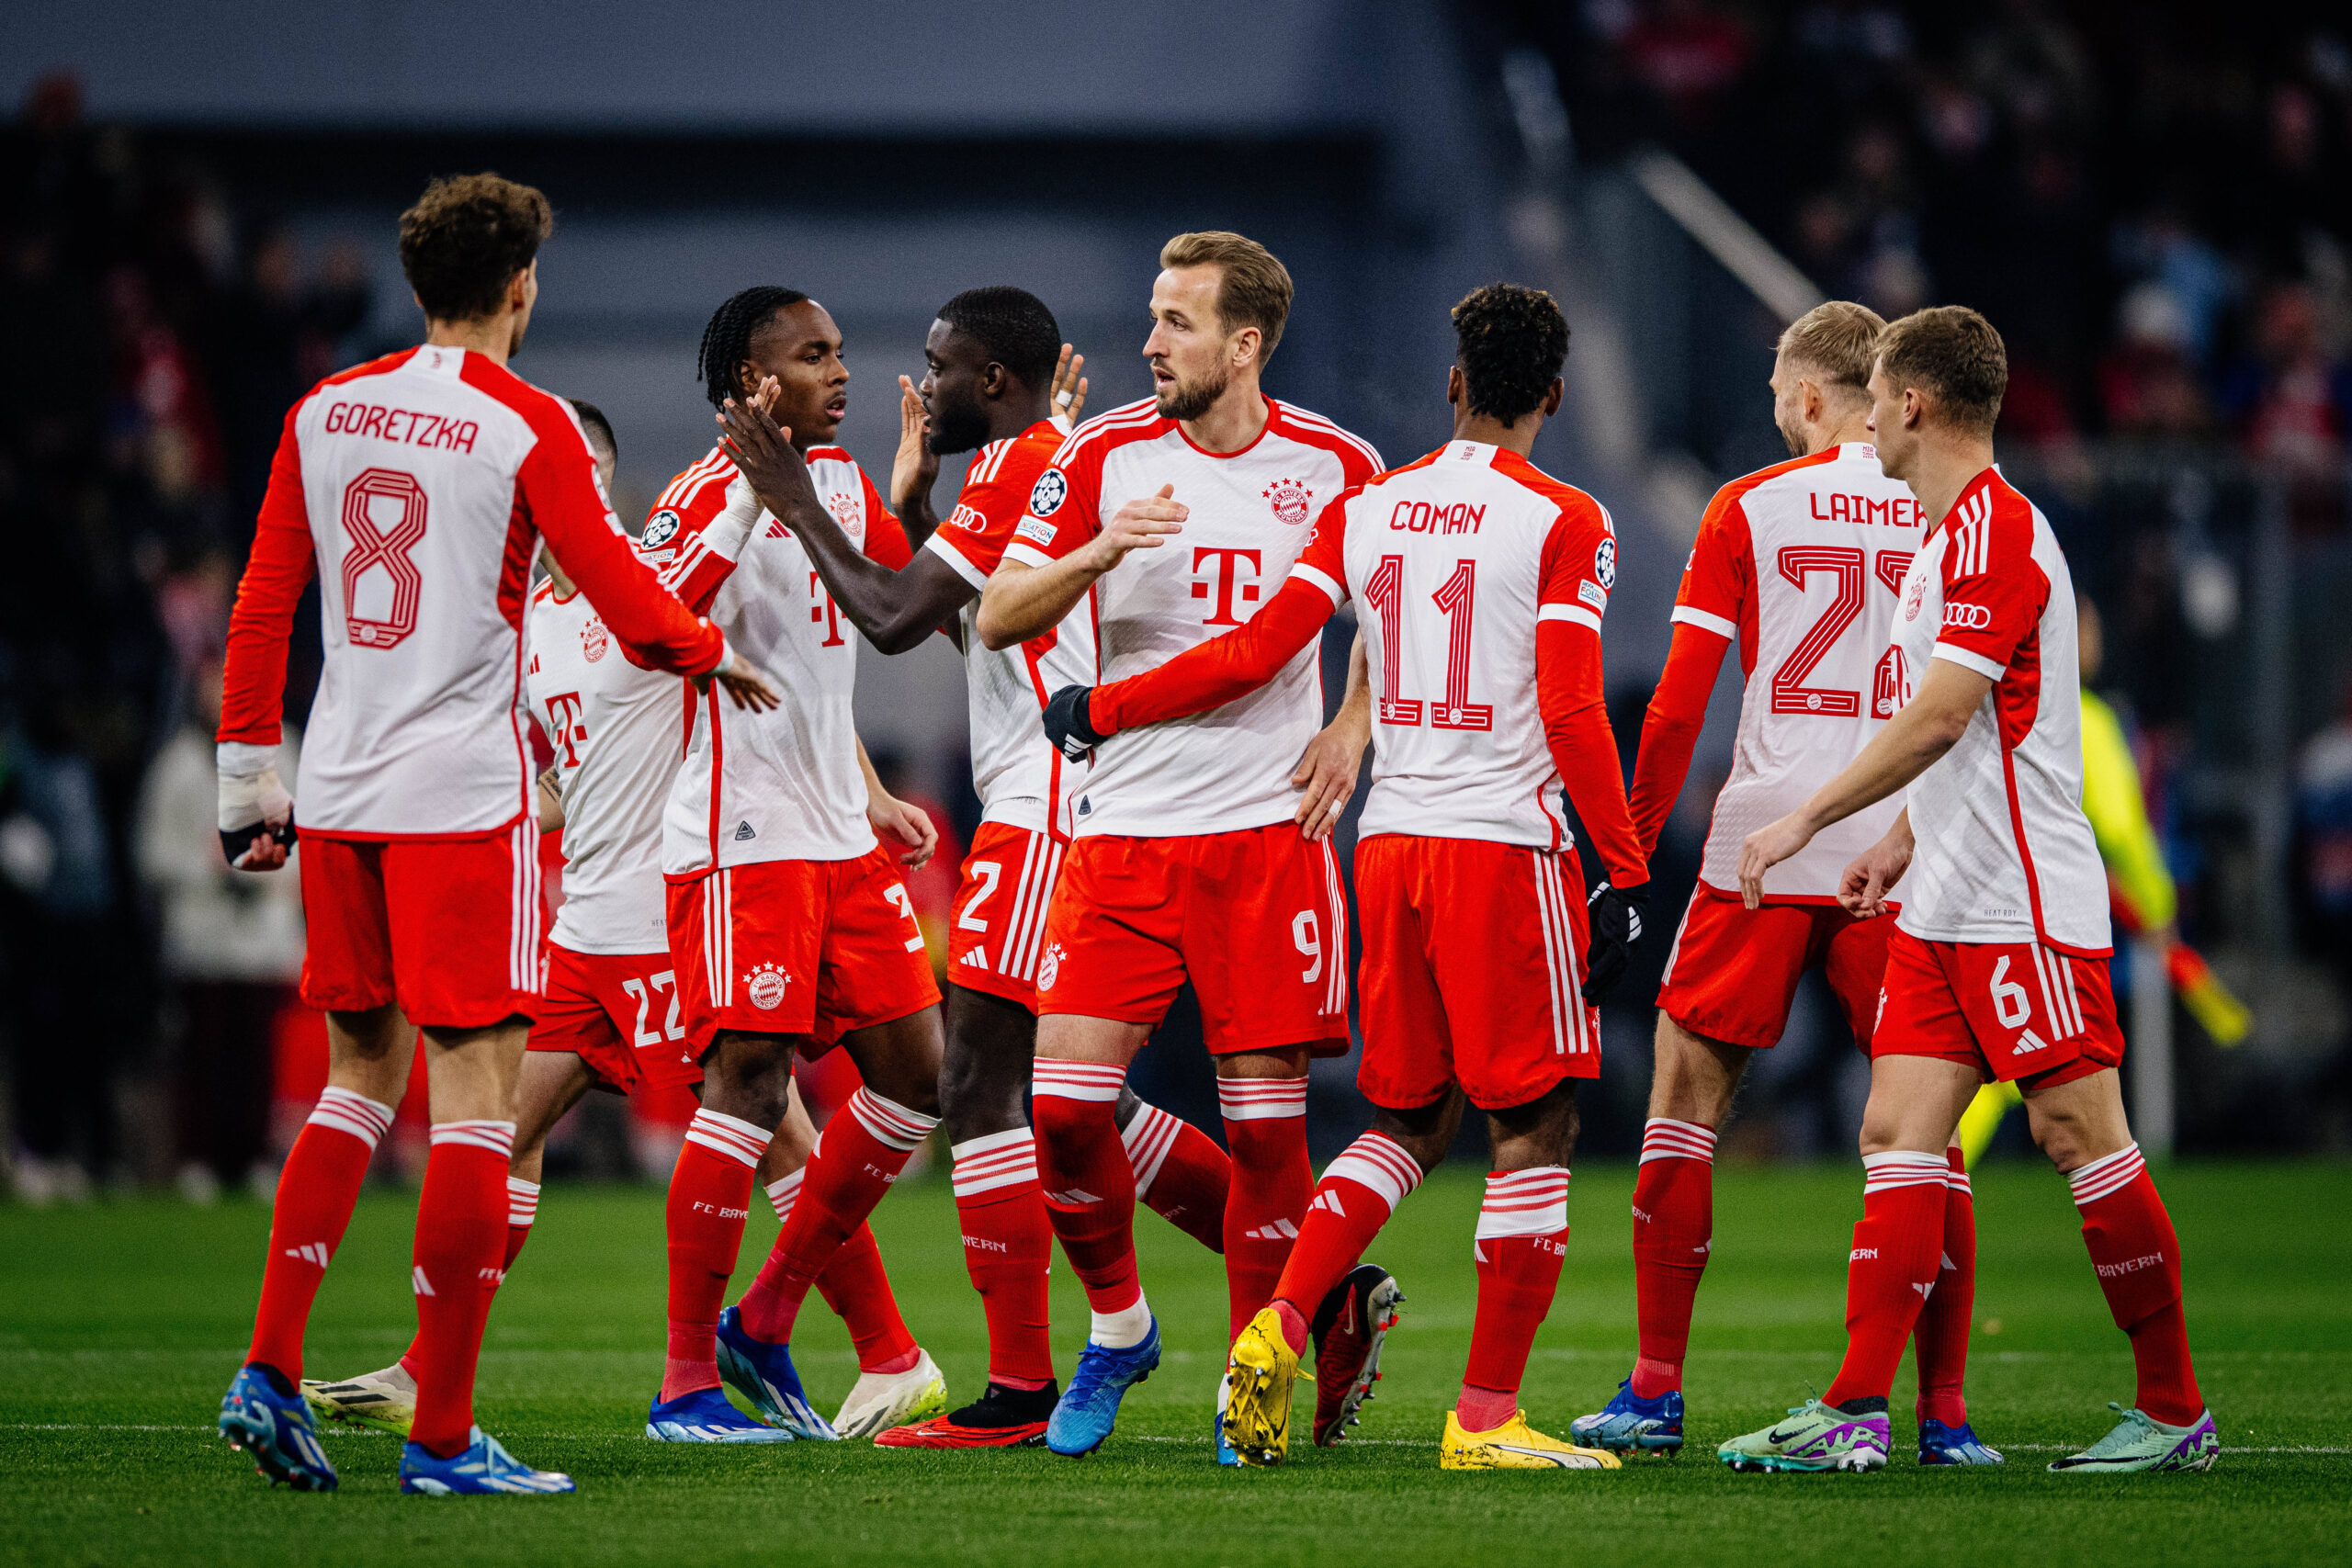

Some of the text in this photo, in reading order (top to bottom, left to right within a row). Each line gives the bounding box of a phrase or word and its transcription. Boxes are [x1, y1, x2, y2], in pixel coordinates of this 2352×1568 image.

[325, 401, 479, 454] GORETZKA
[1389, 501, 1487, 535] COMAN
[341, 467, 428, 650] 8
[1192, 547, 1261, 626] T
[1365, 555, 1493, 731] 11
[545, 691, 588, 768] T
[958, 862, 1001, 932] 2
[1292, 909, 1322, 983] 9
[622, 969, 685, 1048] 22
[1990, 955, 2031, 1029] 6
[693, 1201, 715, 1214] FC
[1533, 1237, 1551, 1251] FC
[2097, 1251, 2164, 1277] BAYERN
